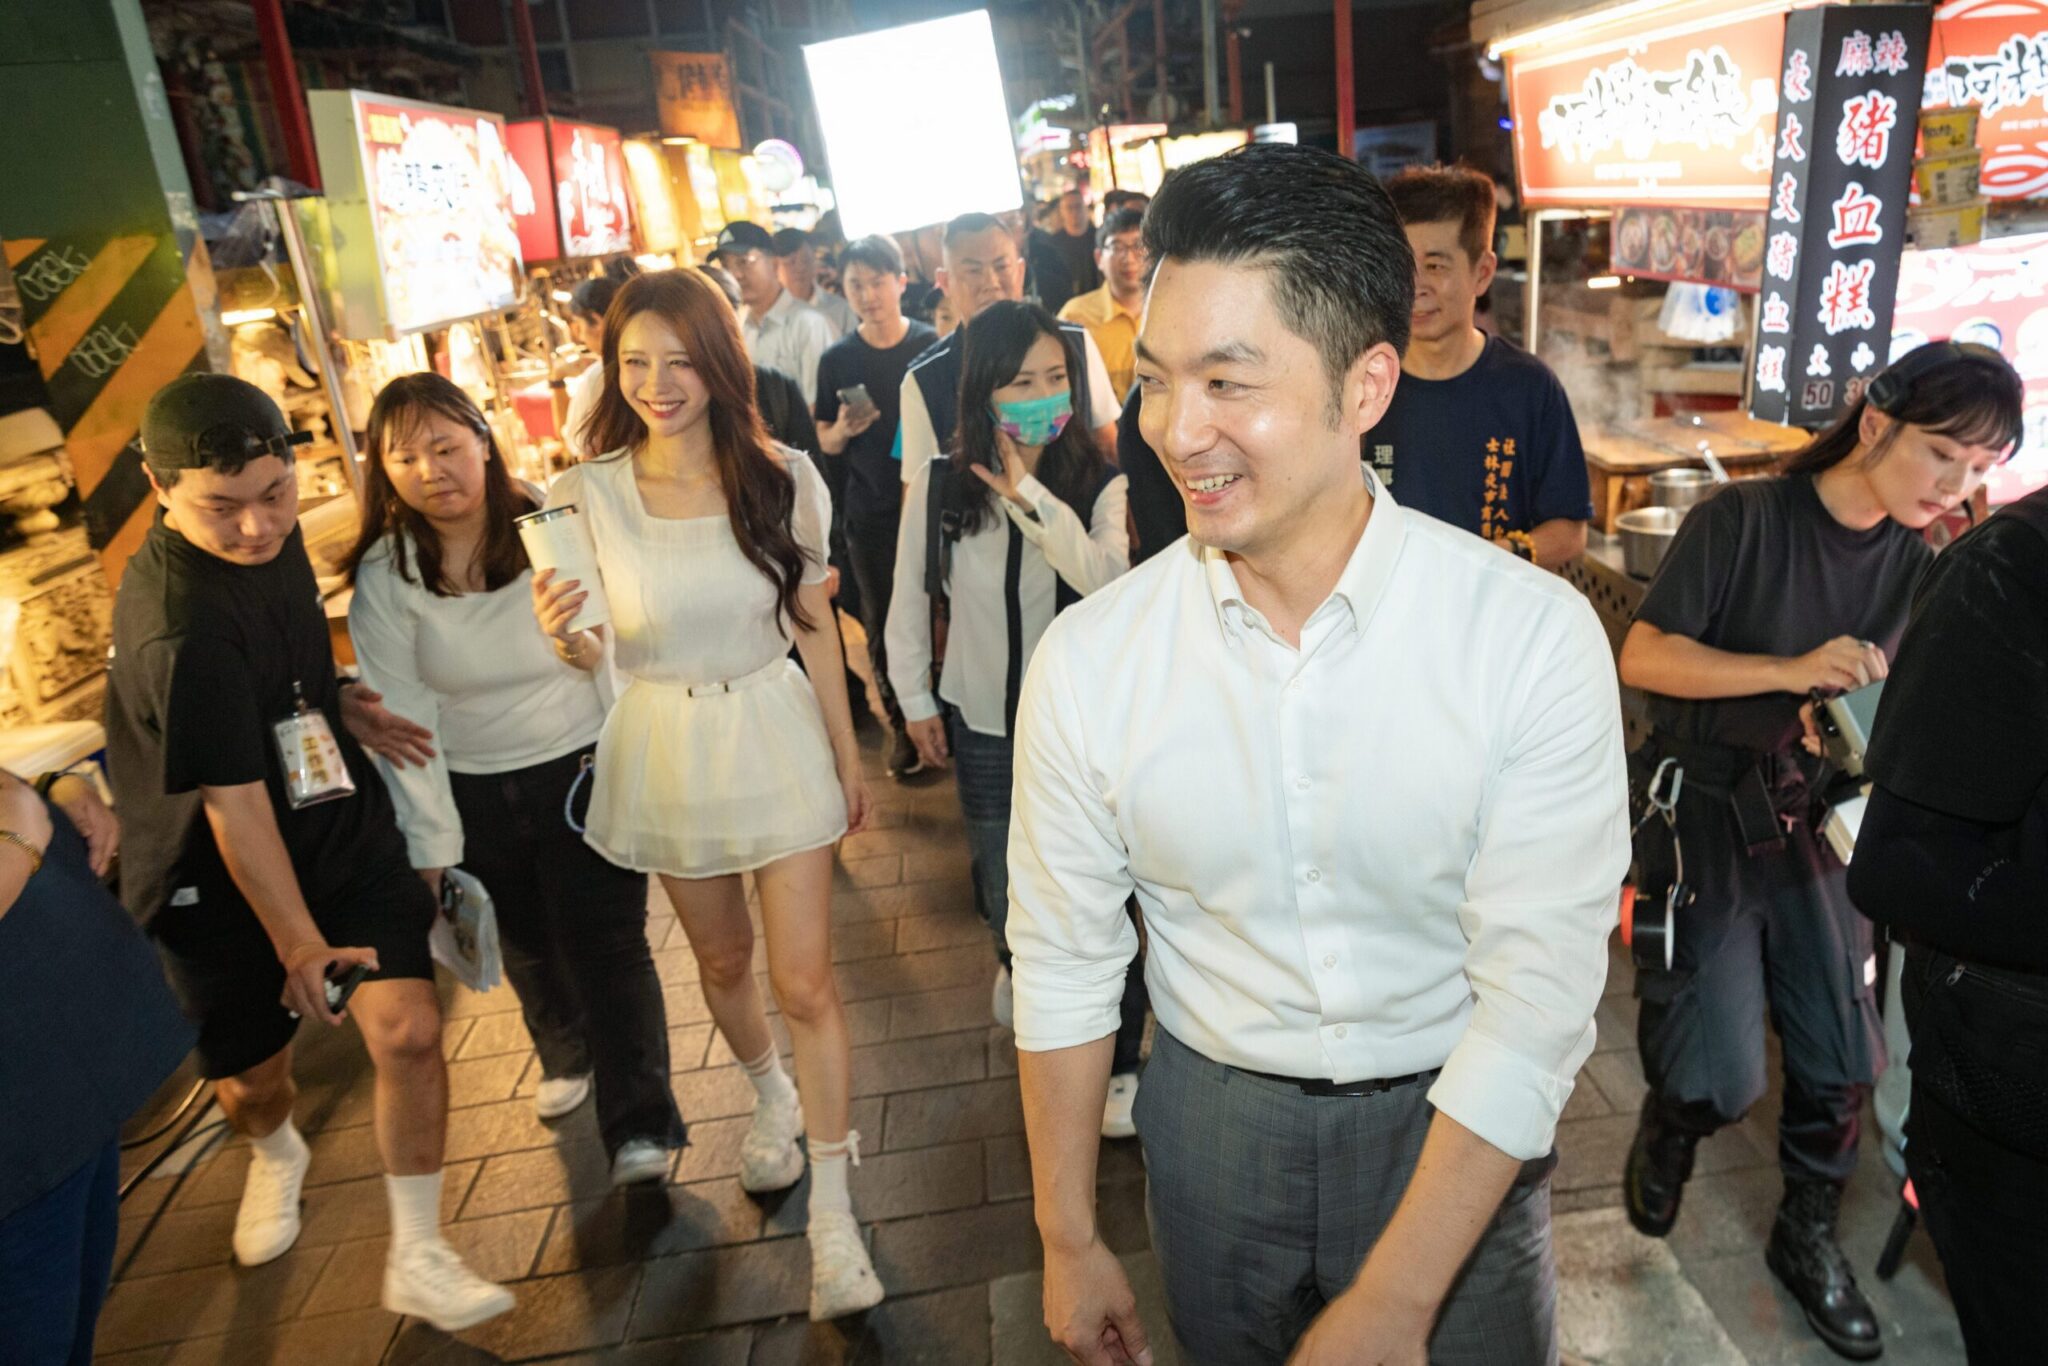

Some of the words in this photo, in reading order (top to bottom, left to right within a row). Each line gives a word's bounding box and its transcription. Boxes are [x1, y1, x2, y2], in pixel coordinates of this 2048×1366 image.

[1835, 30, 1909, 77] 麻辣
[1817, 89, 1898, 336] 豬血糕
[1803, 381, 1833, 407] 50
